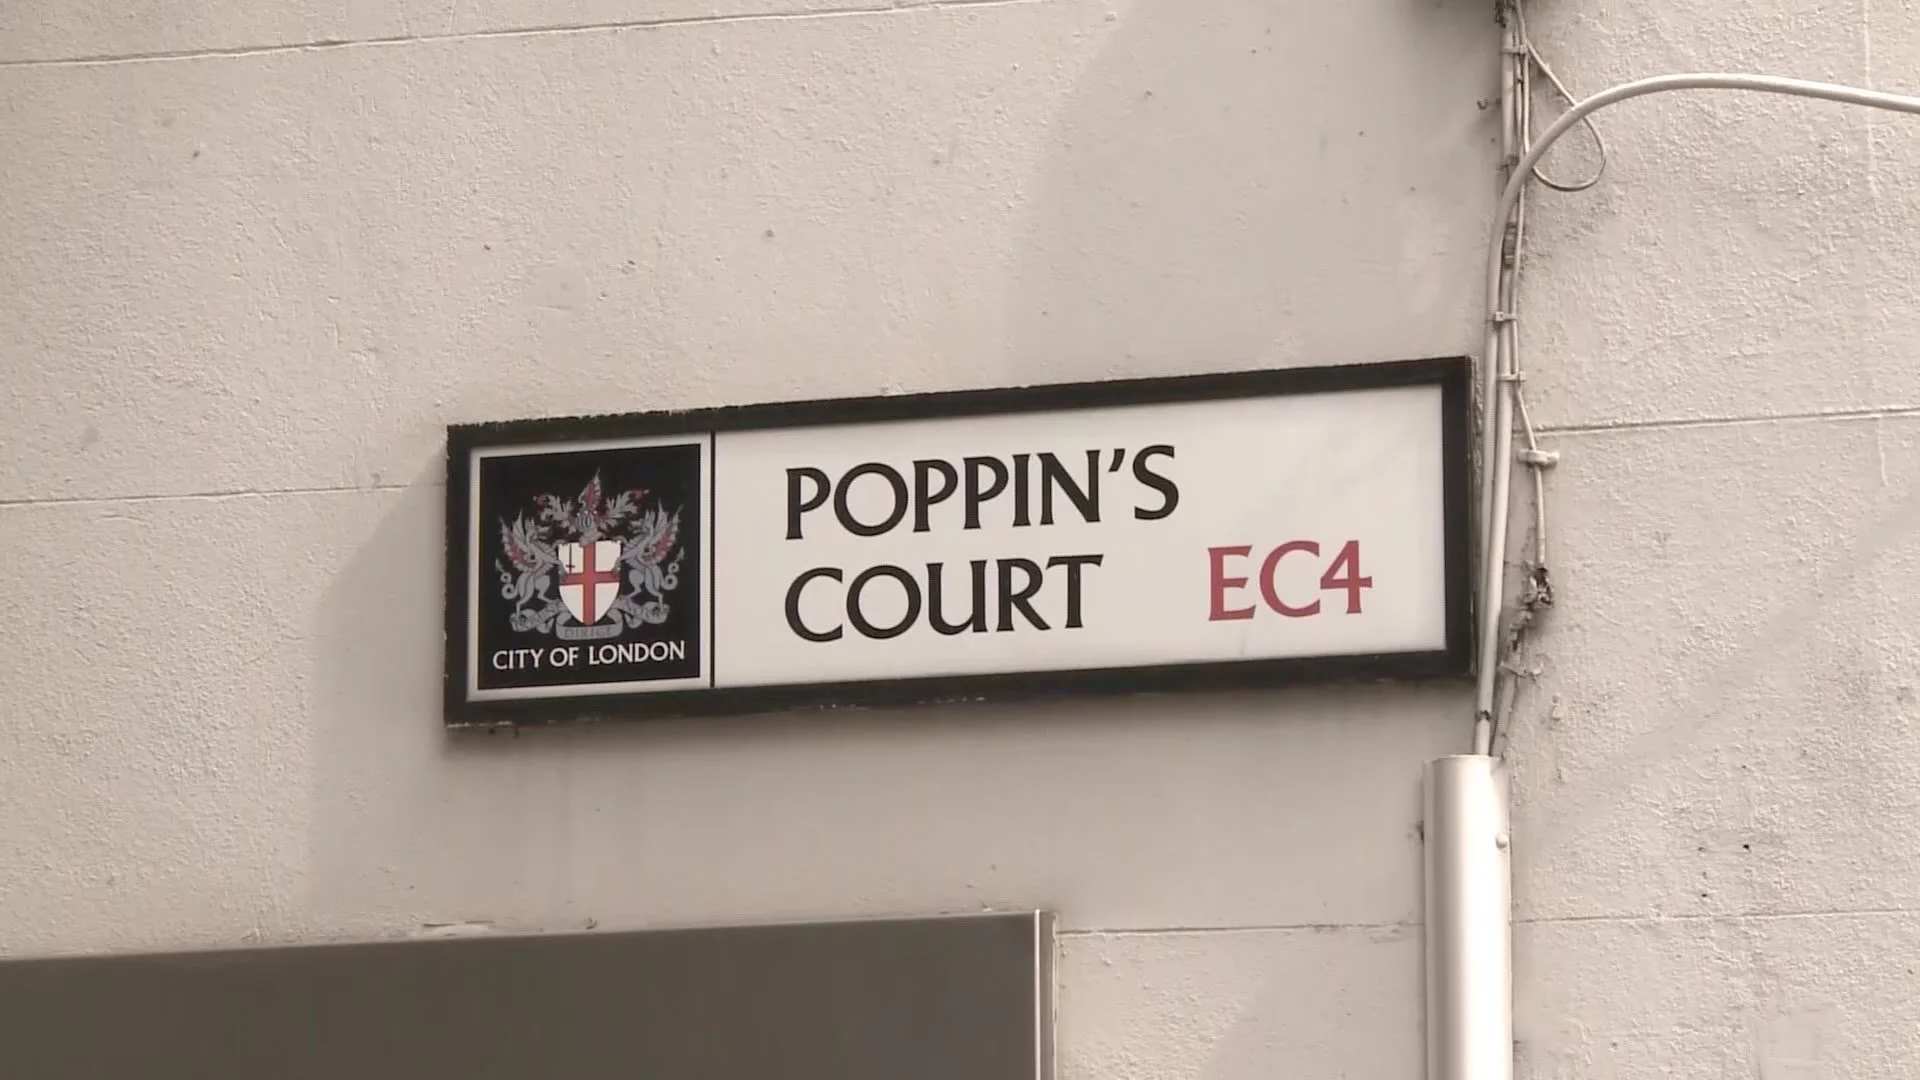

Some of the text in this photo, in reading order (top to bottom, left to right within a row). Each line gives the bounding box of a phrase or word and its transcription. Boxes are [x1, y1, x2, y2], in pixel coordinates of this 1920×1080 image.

[785, 444, 1180, 540] POPPIN'S
[784, 540, 1373, 642] COURT EC4
[492, 640, 685, 670] CITY OF LONDON
